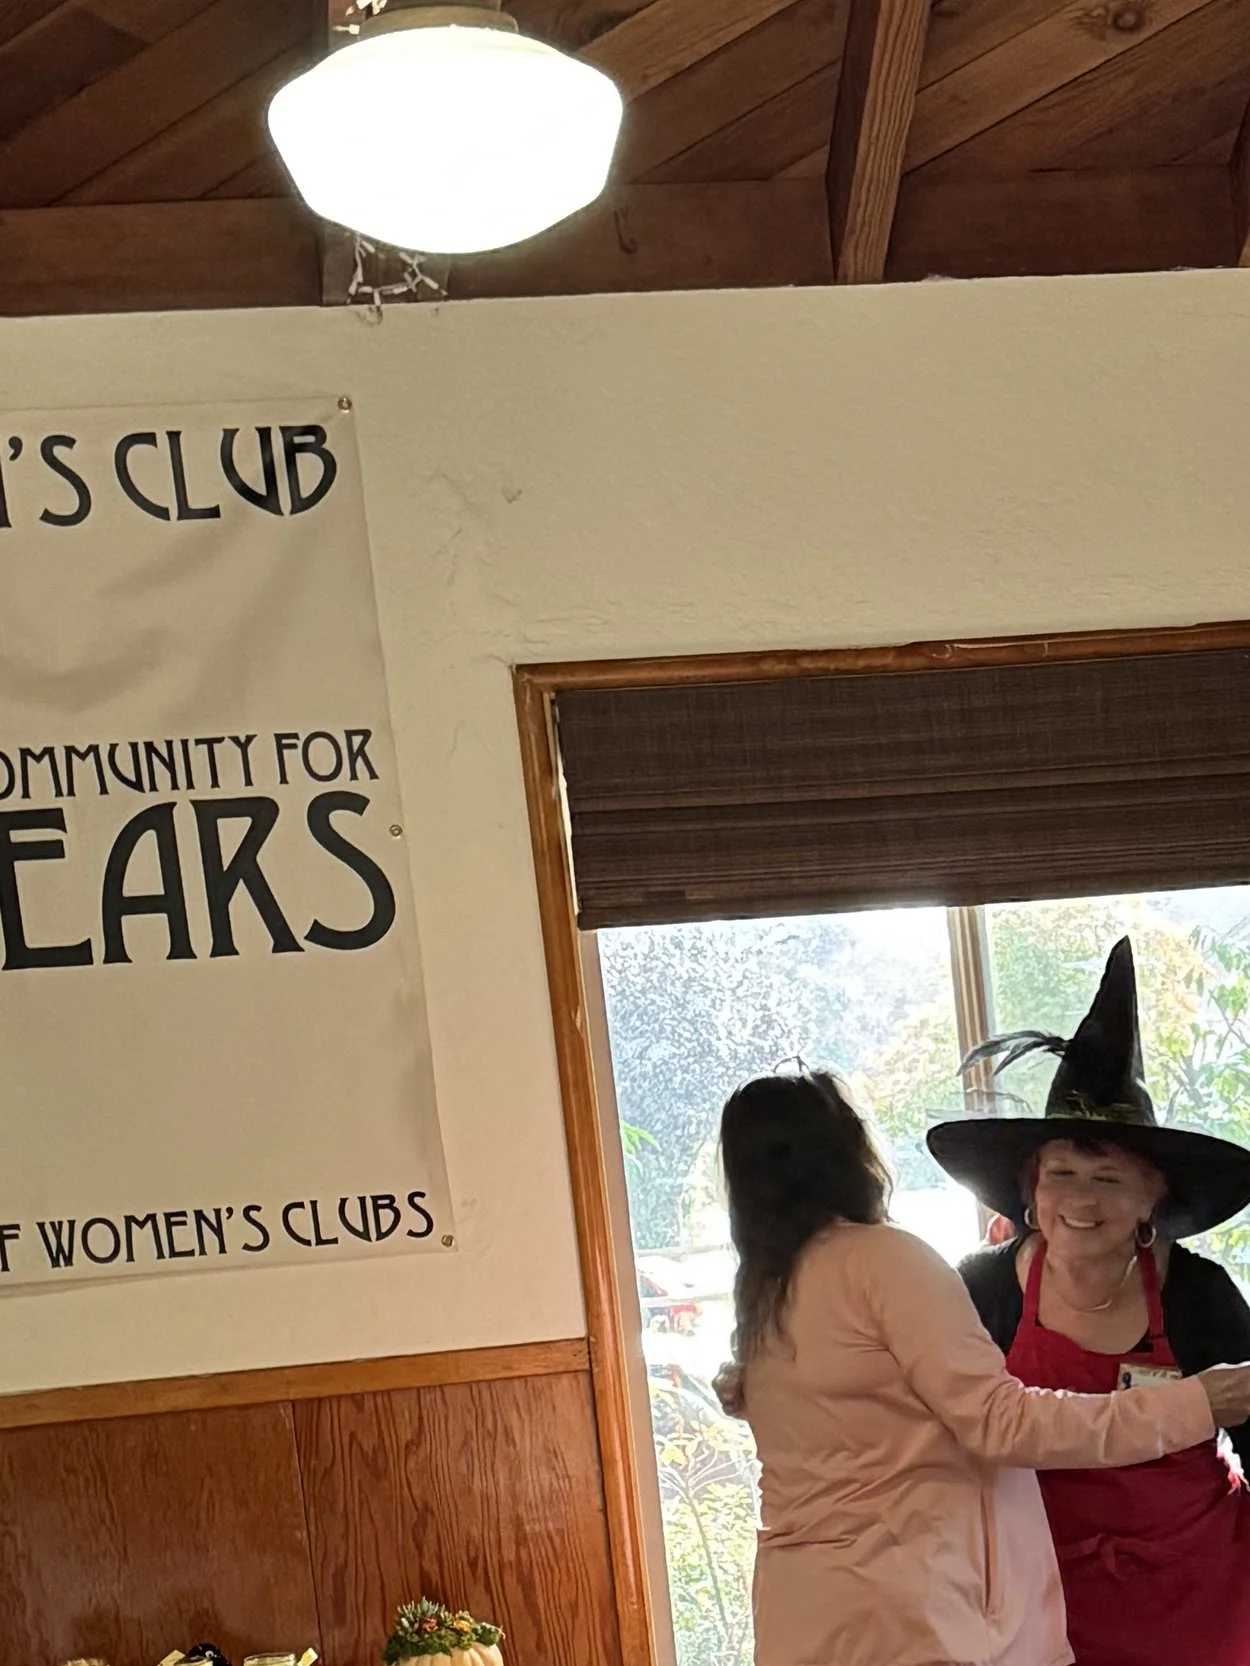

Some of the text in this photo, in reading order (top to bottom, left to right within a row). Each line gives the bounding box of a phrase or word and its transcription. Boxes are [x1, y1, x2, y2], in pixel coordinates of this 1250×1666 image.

[114, 424, 338, 522] CLUB
[273, 729, 380, 785] FOR
[0, 790, 396, 970] EARS
[36, 1204, 270, 1268] WOMEN'S
[282, 1191, 434, 1247] CLUBS
